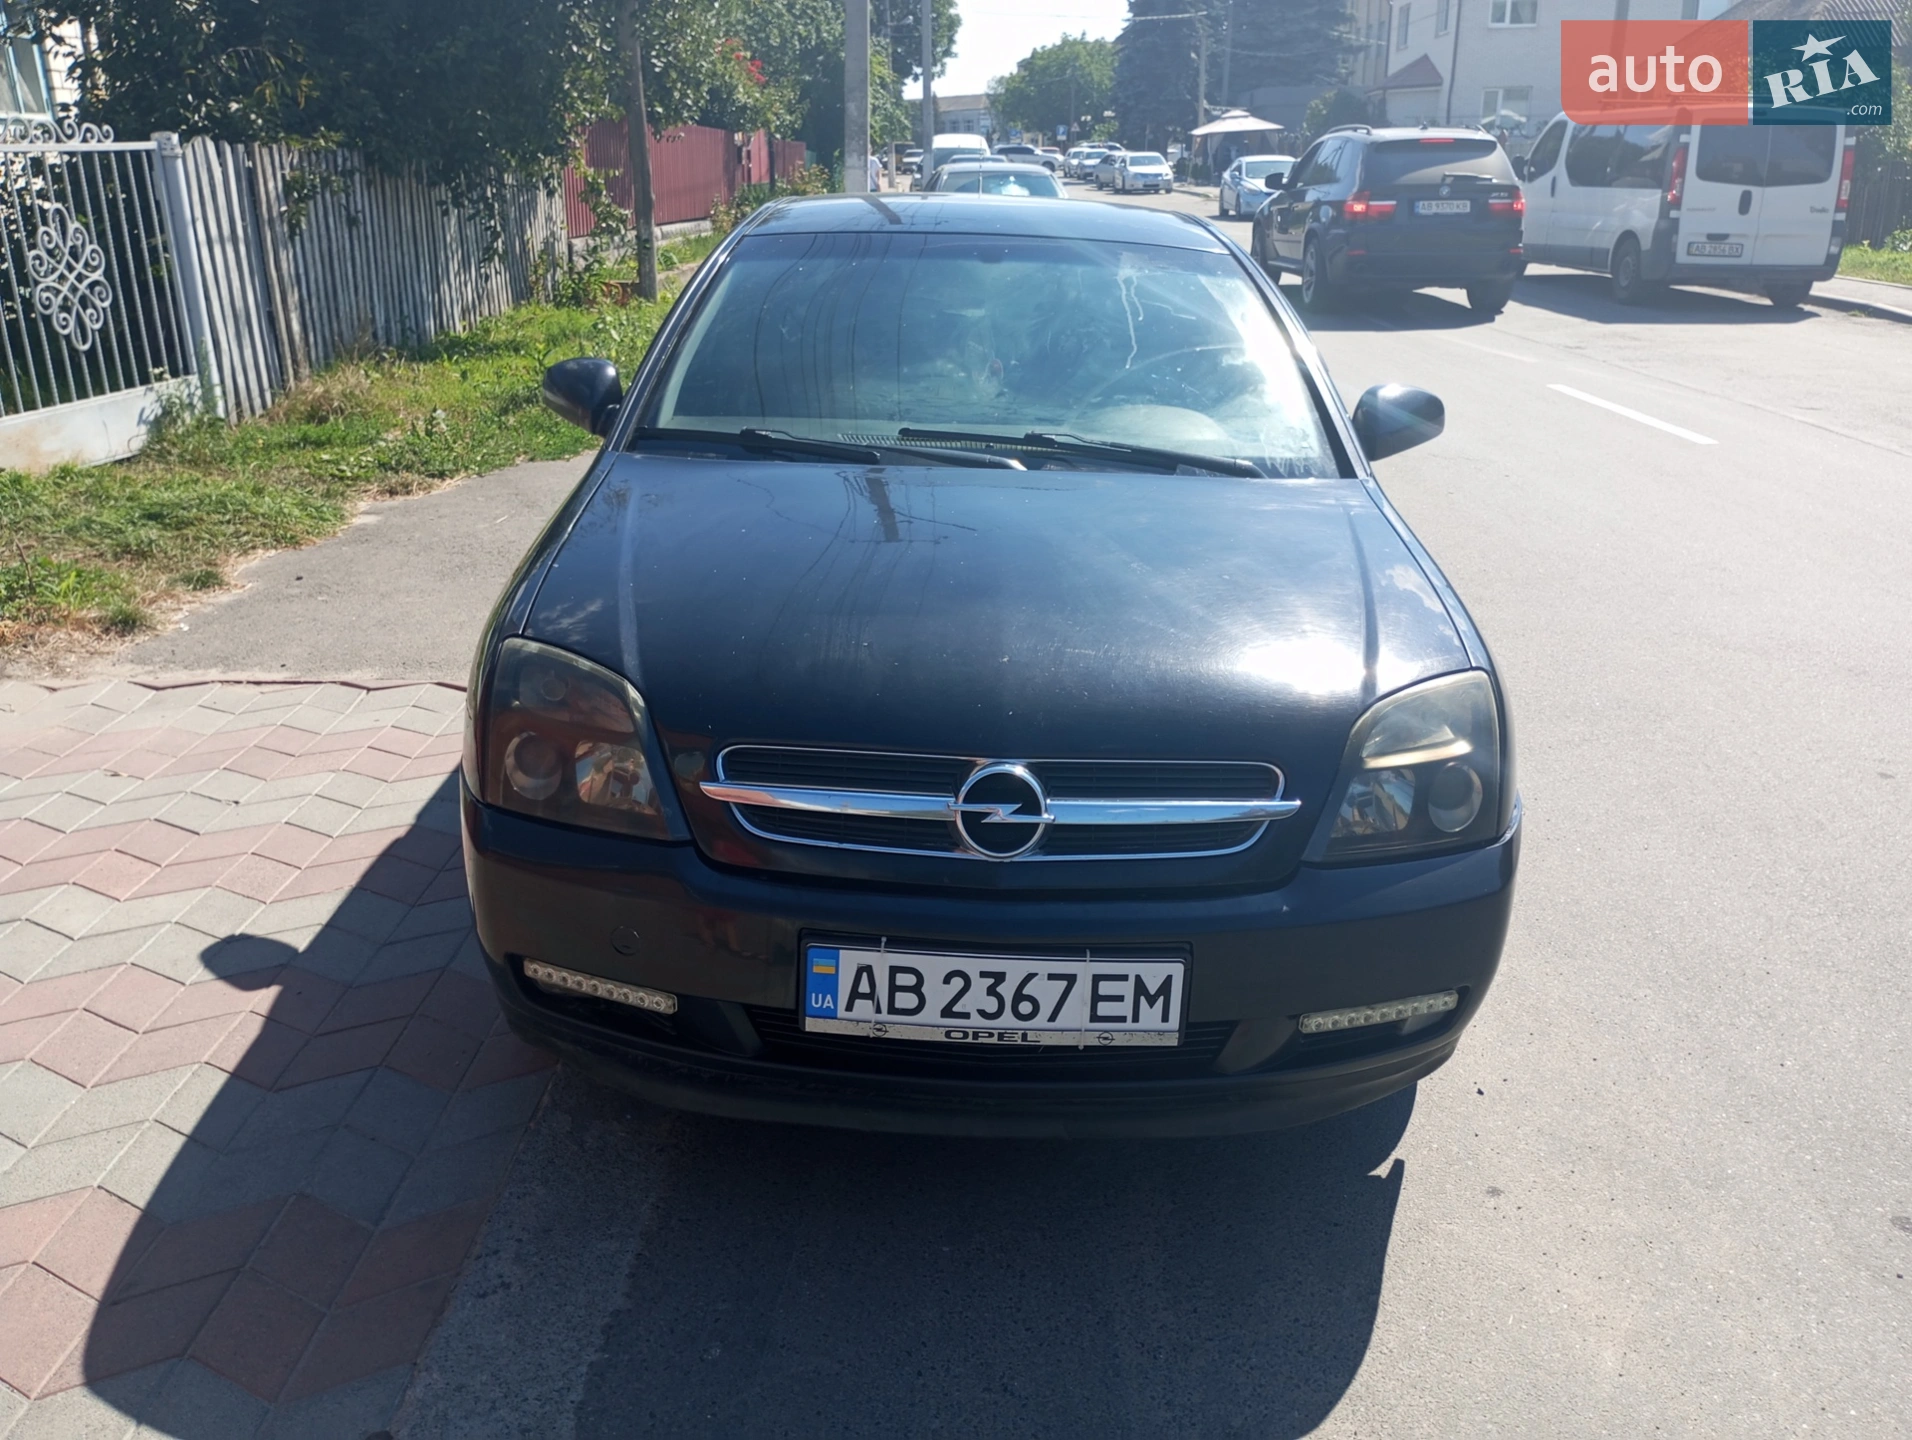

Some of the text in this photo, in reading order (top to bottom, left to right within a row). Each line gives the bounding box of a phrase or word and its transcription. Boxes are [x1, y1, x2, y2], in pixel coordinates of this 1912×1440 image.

[811, 993, 834, 1009] UA
[845, 963, 1172, 1024] AB 2367 EM
[943, 1029, 1041, 1044] OPEL
